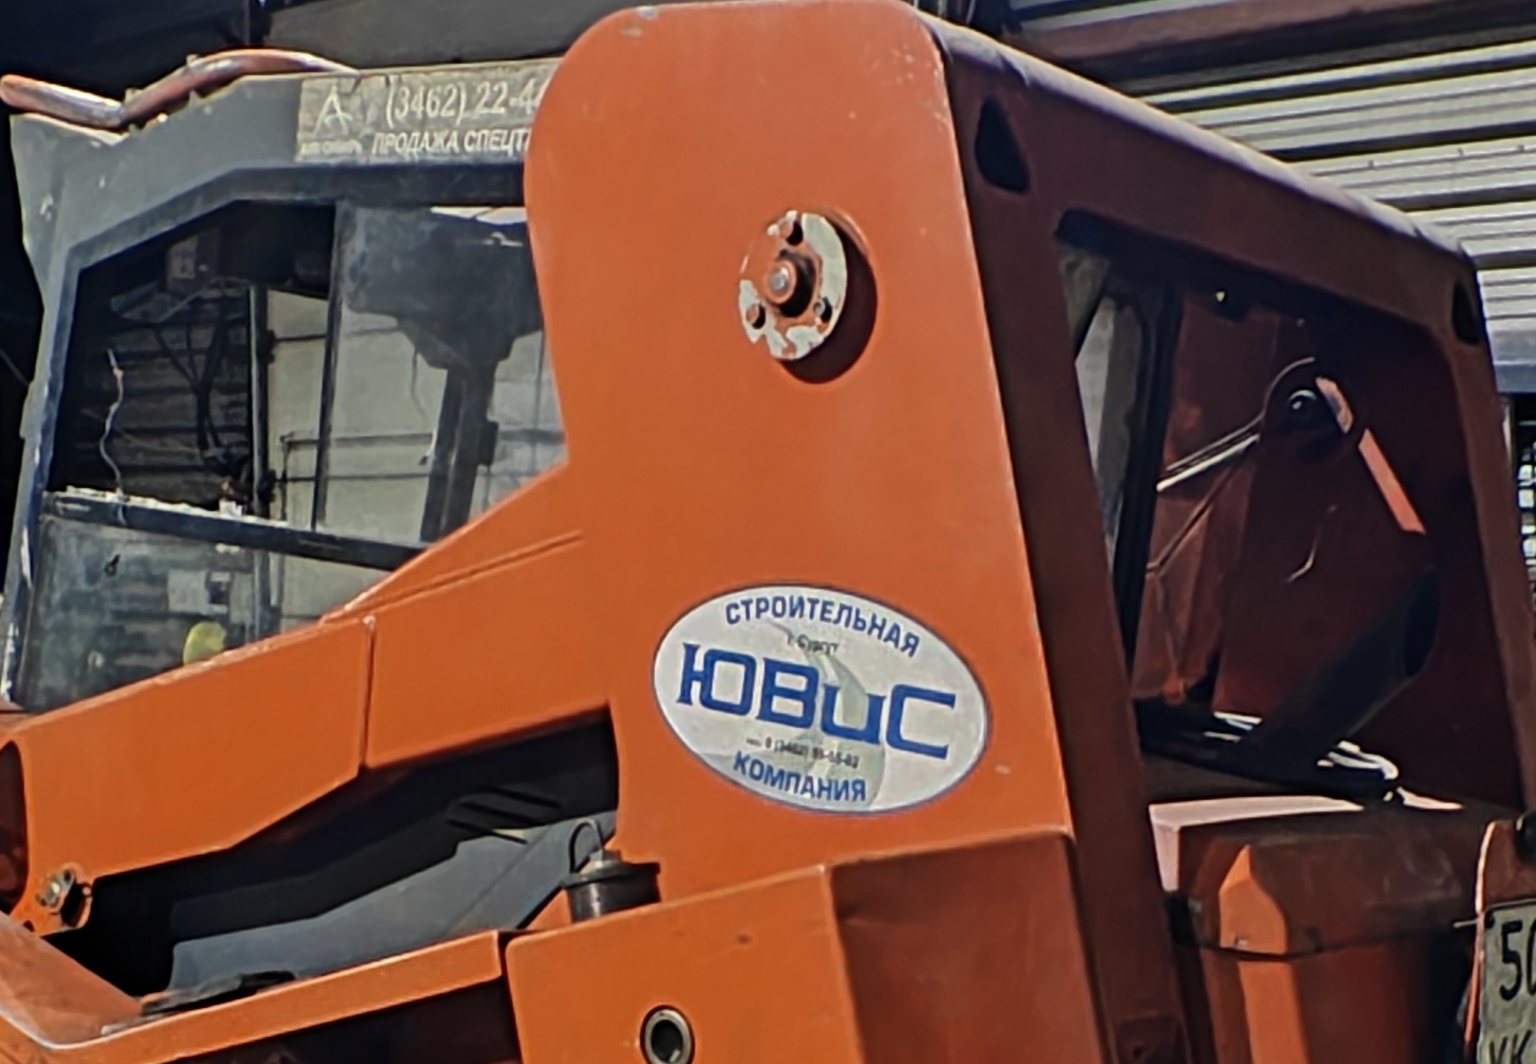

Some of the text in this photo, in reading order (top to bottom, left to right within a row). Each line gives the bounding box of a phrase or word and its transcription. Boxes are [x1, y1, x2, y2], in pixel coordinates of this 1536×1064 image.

[385, 77, 543, 129] (3462) 22-4
[372, 130, 460, 158] ПРОДАЖА
[464, 129, 530, 157] СПЕЦТ
[725, 595, 920, 658] СТРОИТЕЛЬНАЯ
[733, 750, 867, 802] КОМПАНИЯ
